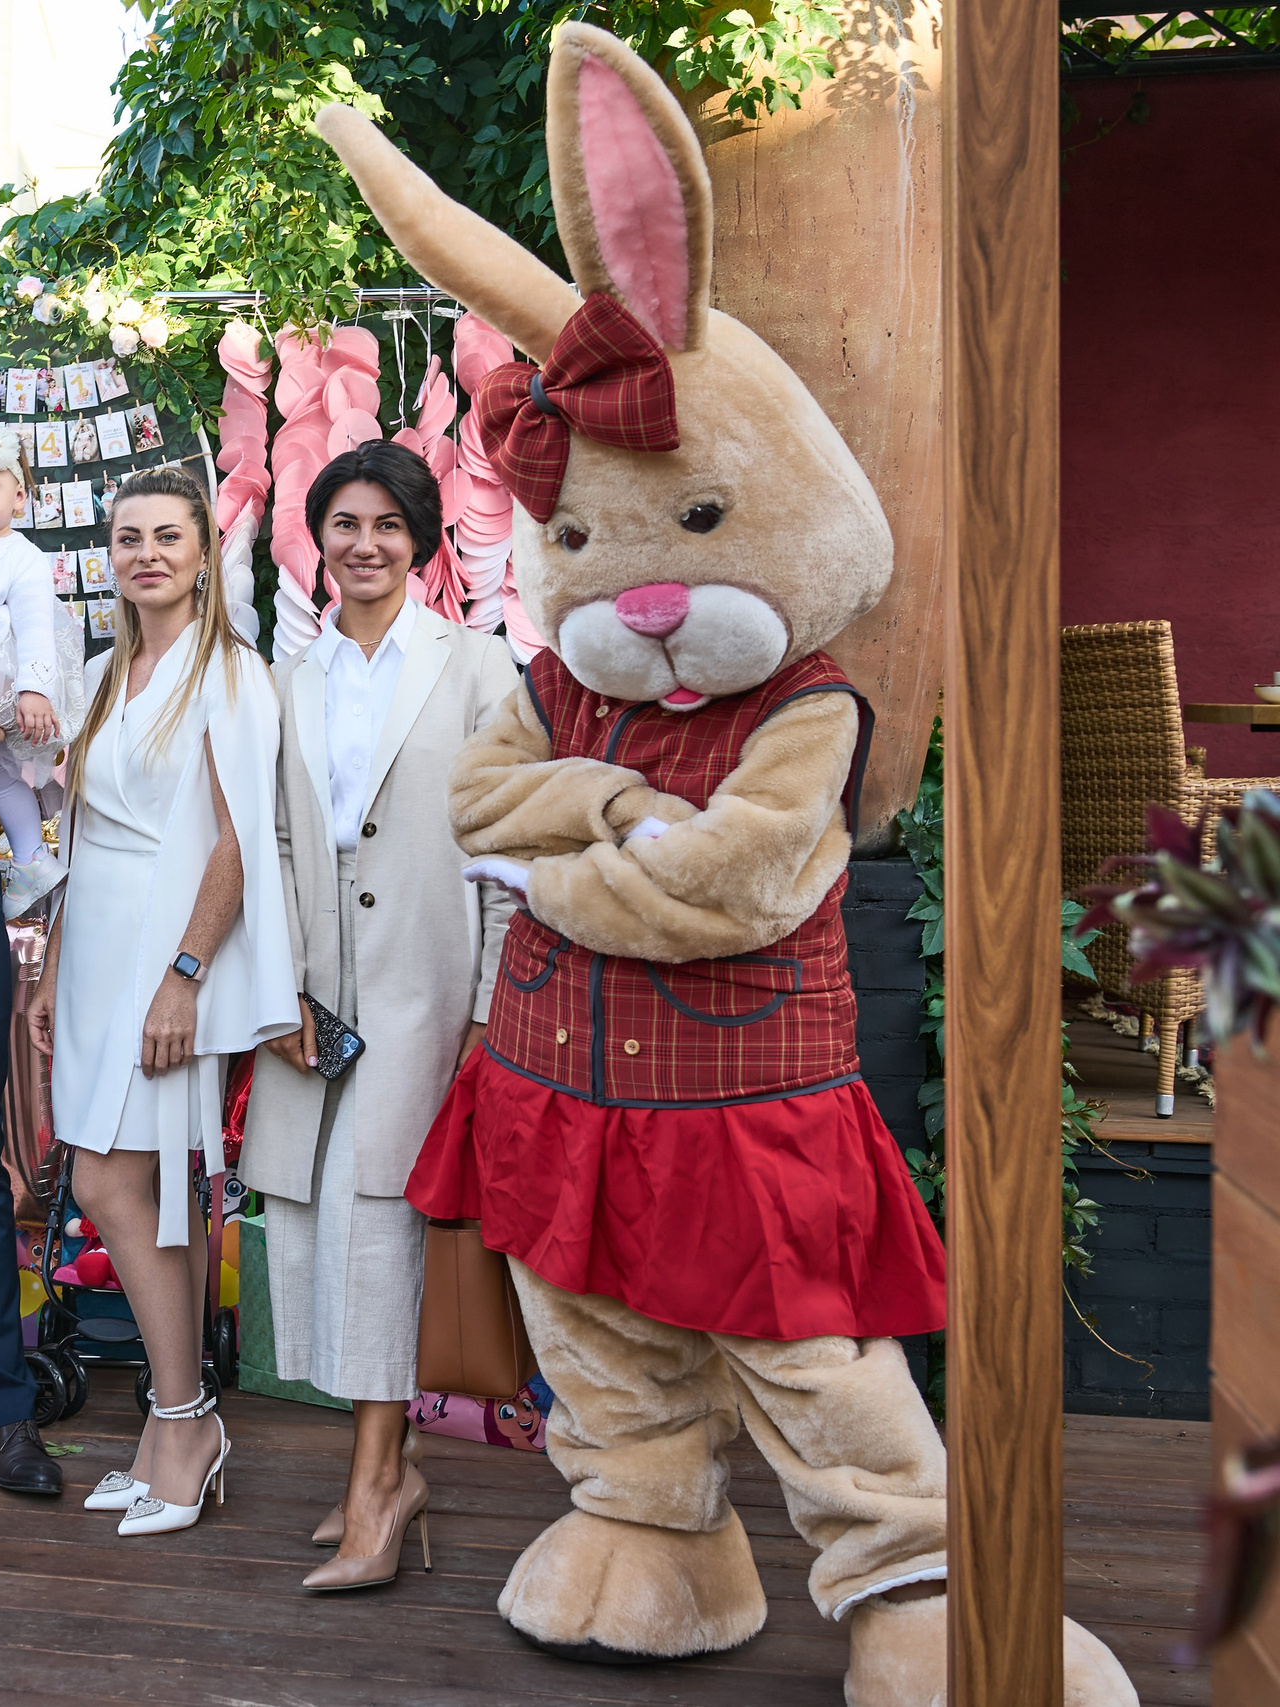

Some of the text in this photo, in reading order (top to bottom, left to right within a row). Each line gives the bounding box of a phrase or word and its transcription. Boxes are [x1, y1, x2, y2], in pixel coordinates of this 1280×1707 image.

[70, 373, 84, 397] 1
[40, 432, 56, 454] 4
[85, 558, 102, 583] 8
[91, 609, 116, 631] 11
